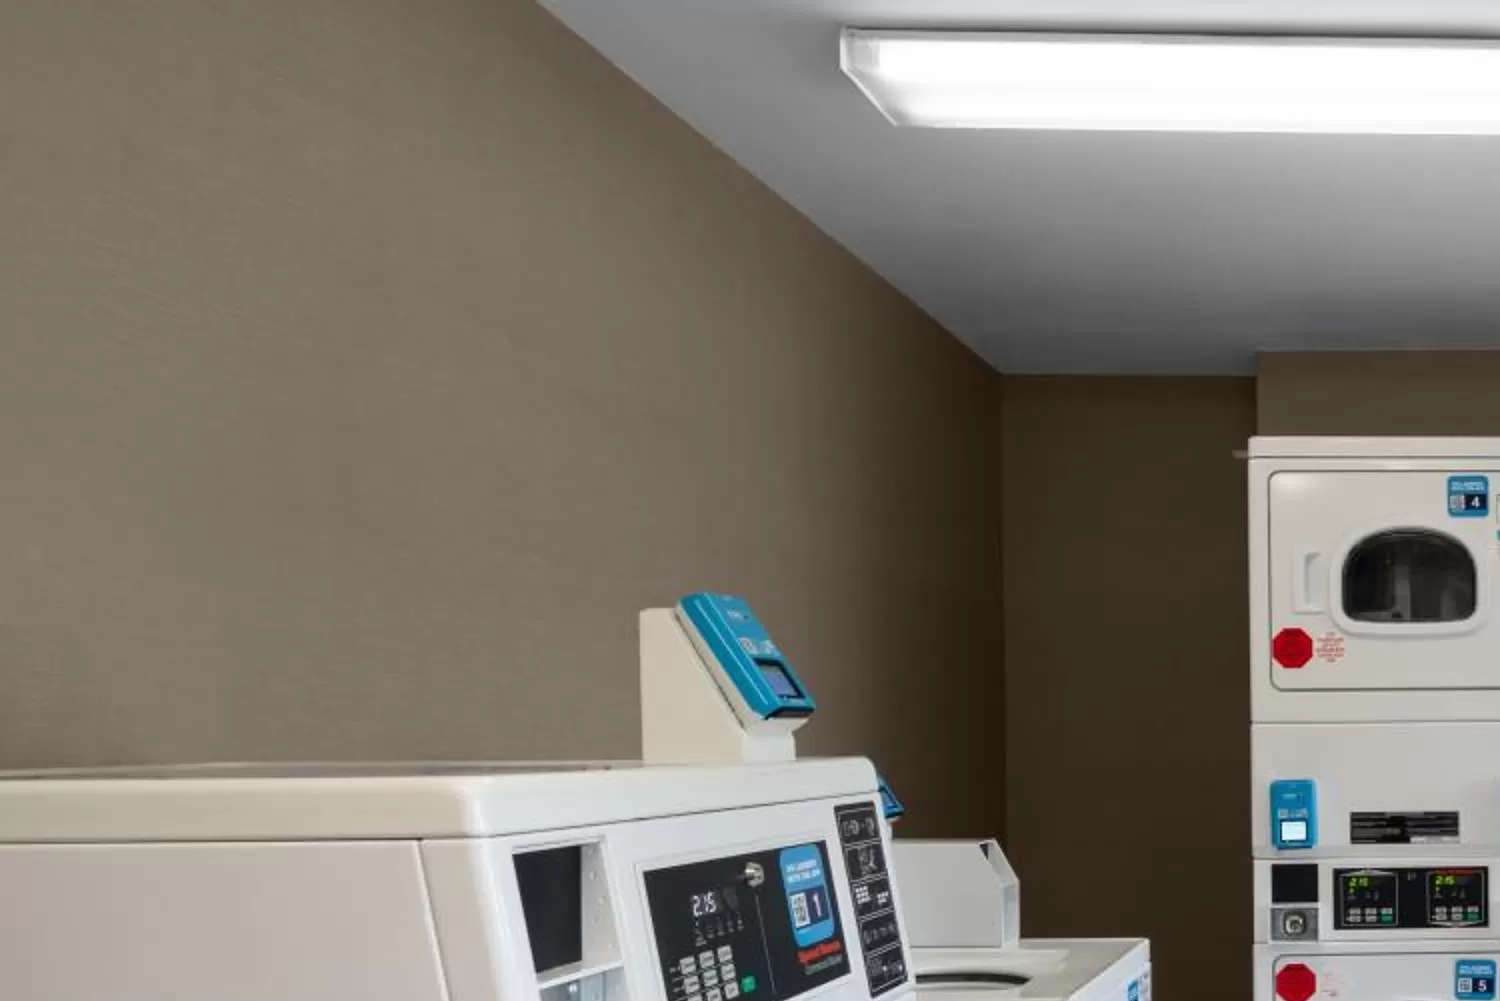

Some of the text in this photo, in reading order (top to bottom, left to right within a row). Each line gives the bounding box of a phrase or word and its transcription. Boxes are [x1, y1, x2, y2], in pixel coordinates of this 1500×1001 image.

[1471, 496, 1481, 508] 4
[812, 892, 822, 917] 1
[1478, 980, 1488, 992] 5
